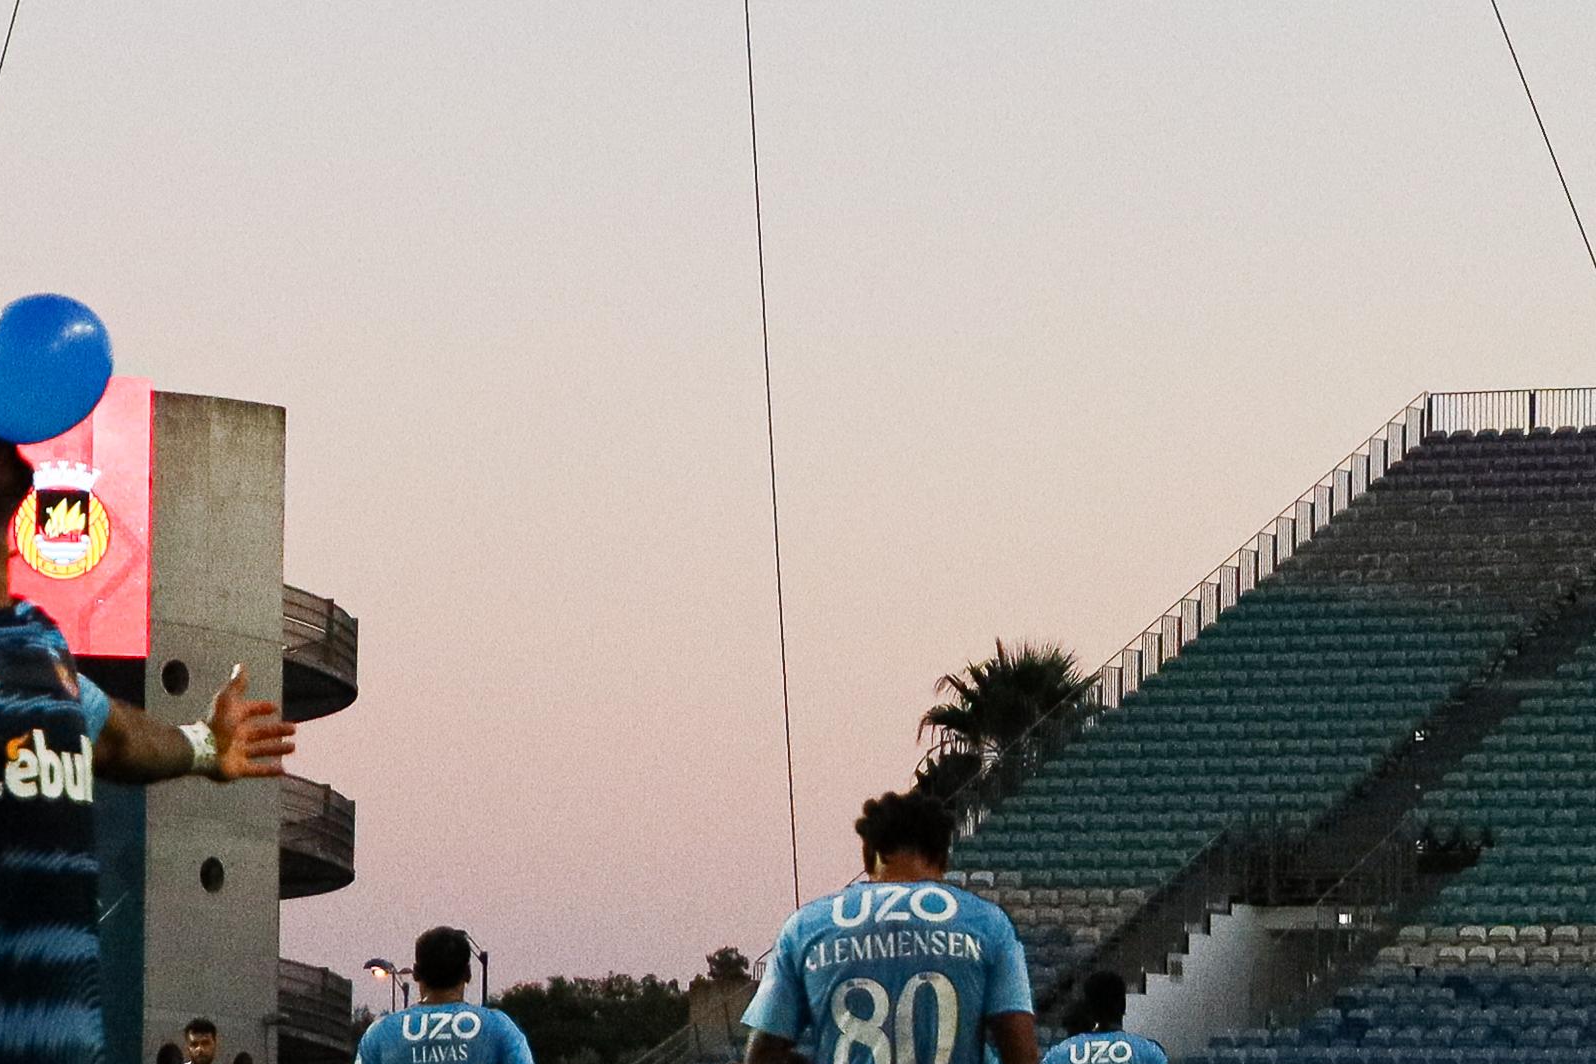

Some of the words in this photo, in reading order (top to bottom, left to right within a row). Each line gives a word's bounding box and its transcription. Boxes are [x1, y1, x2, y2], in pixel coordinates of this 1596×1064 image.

[832, 886, 958, 927] UZO
[806, 930, 982, 971] CLEMMENSEN
[402, 1011, 482, 1041] UZO
[1070, 1041, 1132, 1064] UZO
